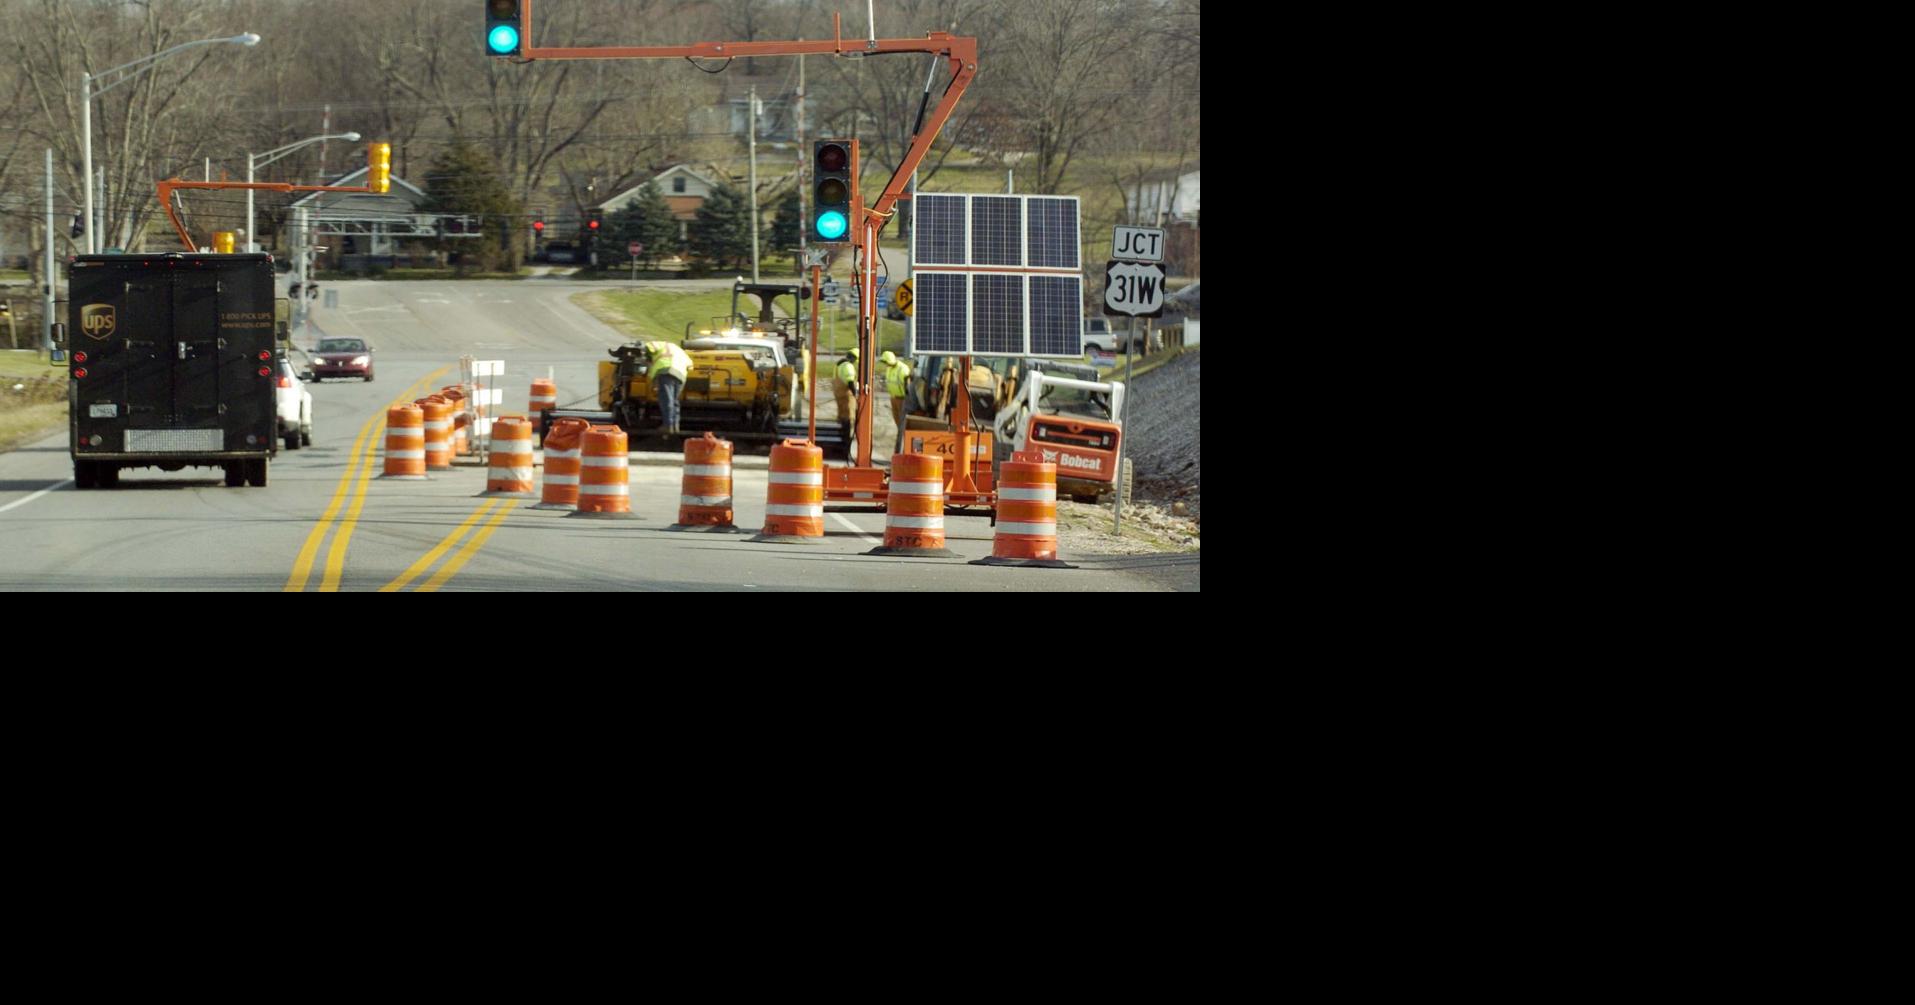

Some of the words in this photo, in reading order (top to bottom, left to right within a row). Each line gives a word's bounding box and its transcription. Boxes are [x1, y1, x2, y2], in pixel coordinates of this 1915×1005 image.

[1118, 232, 1160, 255] JCT
[900, 291, 909, 302] R
[1113, 274, 1156, 305] 31W
[84, 315, 113, 335] ups
[1061, 453, 1102, 471] Bobcat
[895, 535, 922, 547] STC
